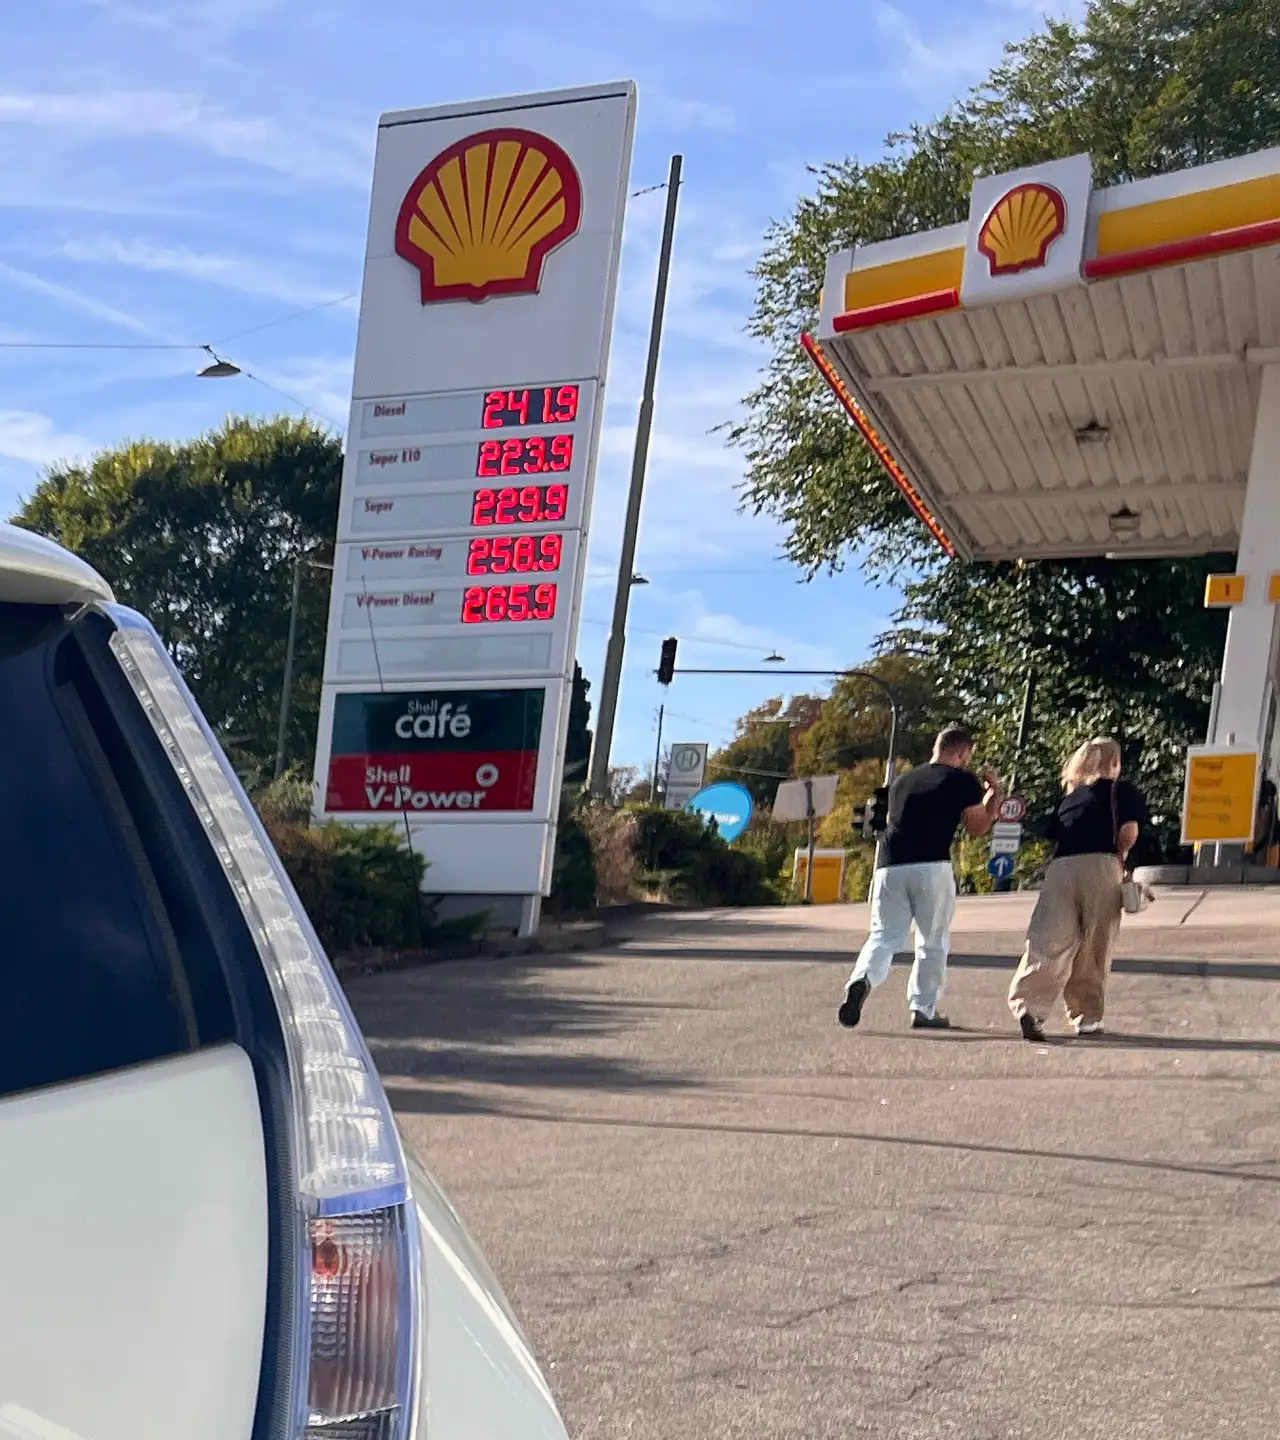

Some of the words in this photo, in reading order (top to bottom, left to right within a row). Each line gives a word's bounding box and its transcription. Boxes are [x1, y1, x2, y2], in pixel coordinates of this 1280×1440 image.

[373, 403, 406, 417] Diesel
[483, 385, 579, 429] 241.9
[369, 452, 398, 468] Super
[402, 448, 421, 463] E10
[477, 434, 573, 476] 223.9
[365, 501, 394, 515] Super
[472, 484, 568, 526] 229.9
[362, 548, 403, 560] V-Power
[408, 545, 442, 560] Racing
[467, 534, 562, 575] 258.9
[403, 592, 435, 606] Diesel
[462, 584, 556, 623] 265.9
[395, 703, 471, 738] café
[407, 700, 438, 714] Shell
[365, 765, 410, 784] Shell
[365, 785, 487, 809] V-Power
